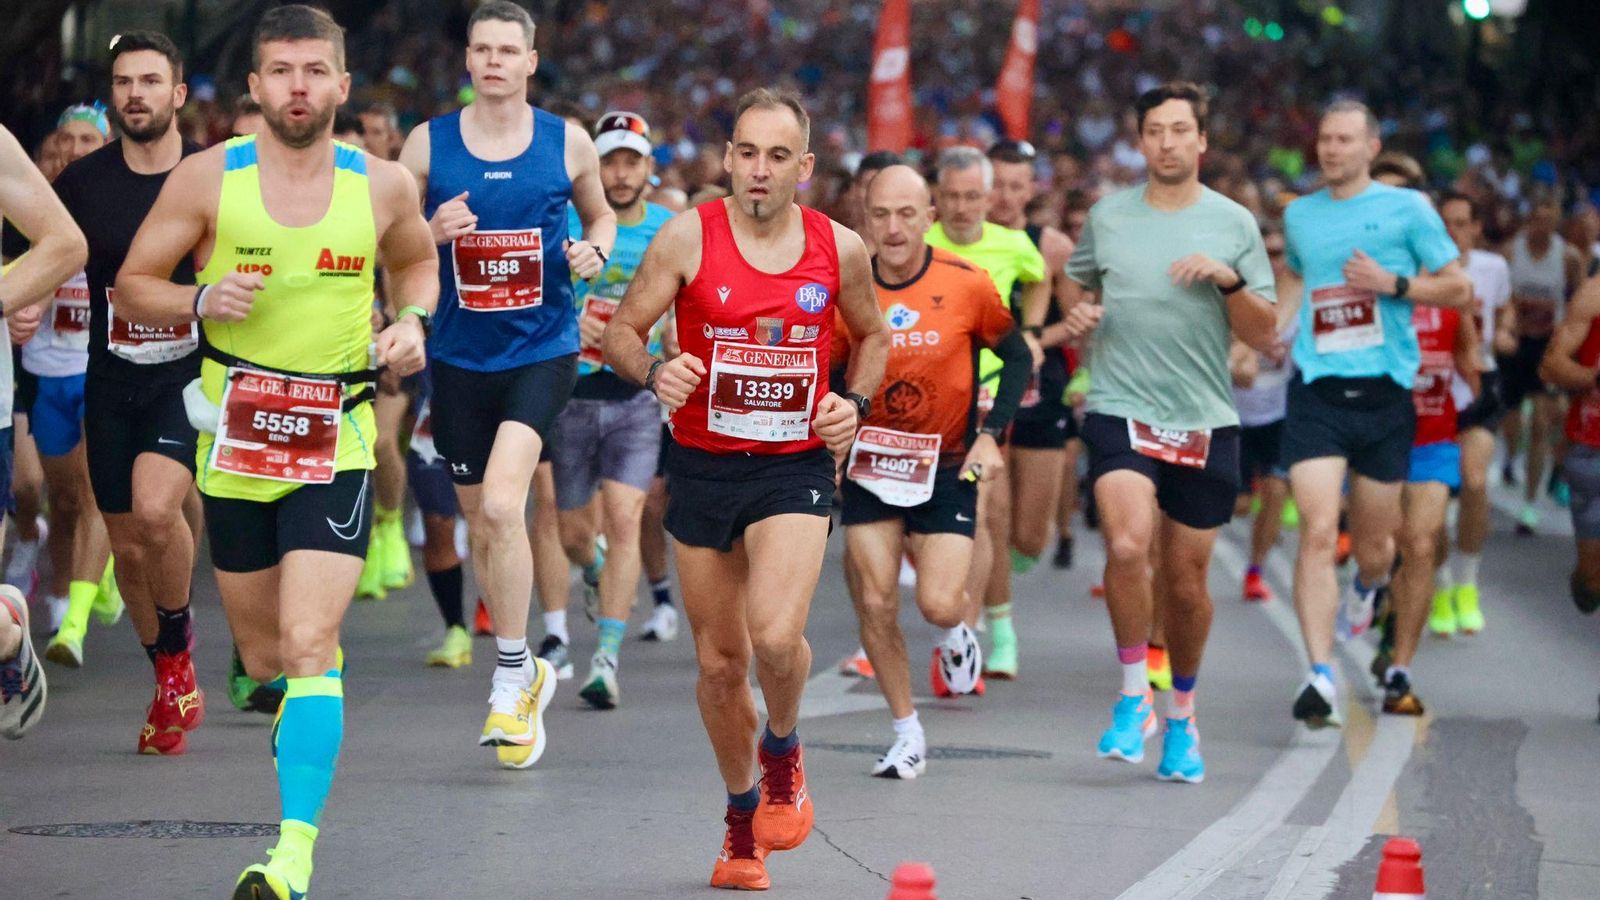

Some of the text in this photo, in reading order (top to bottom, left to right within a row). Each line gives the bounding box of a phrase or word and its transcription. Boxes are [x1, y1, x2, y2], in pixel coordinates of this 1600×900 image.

[484, 171, 512, 180] FUSION
[477, 234, 536, 248] GENERALI
[235, 247, 272, 256] TRIMTEX
[315, 248, 366, 271] Anu
[477, 259, 520, 276] 1588
[714, 326, 749, 336] EGEA
[743, 350, 808, 367] GENERALI
[734, 379, 795, 401] 13339
[744, 399, 782, 408] SALVATORE
[252, 410, 310, 437] 5558
[268, 432, 290, 443] EERO
[869, 455, 919, 474] 14007
